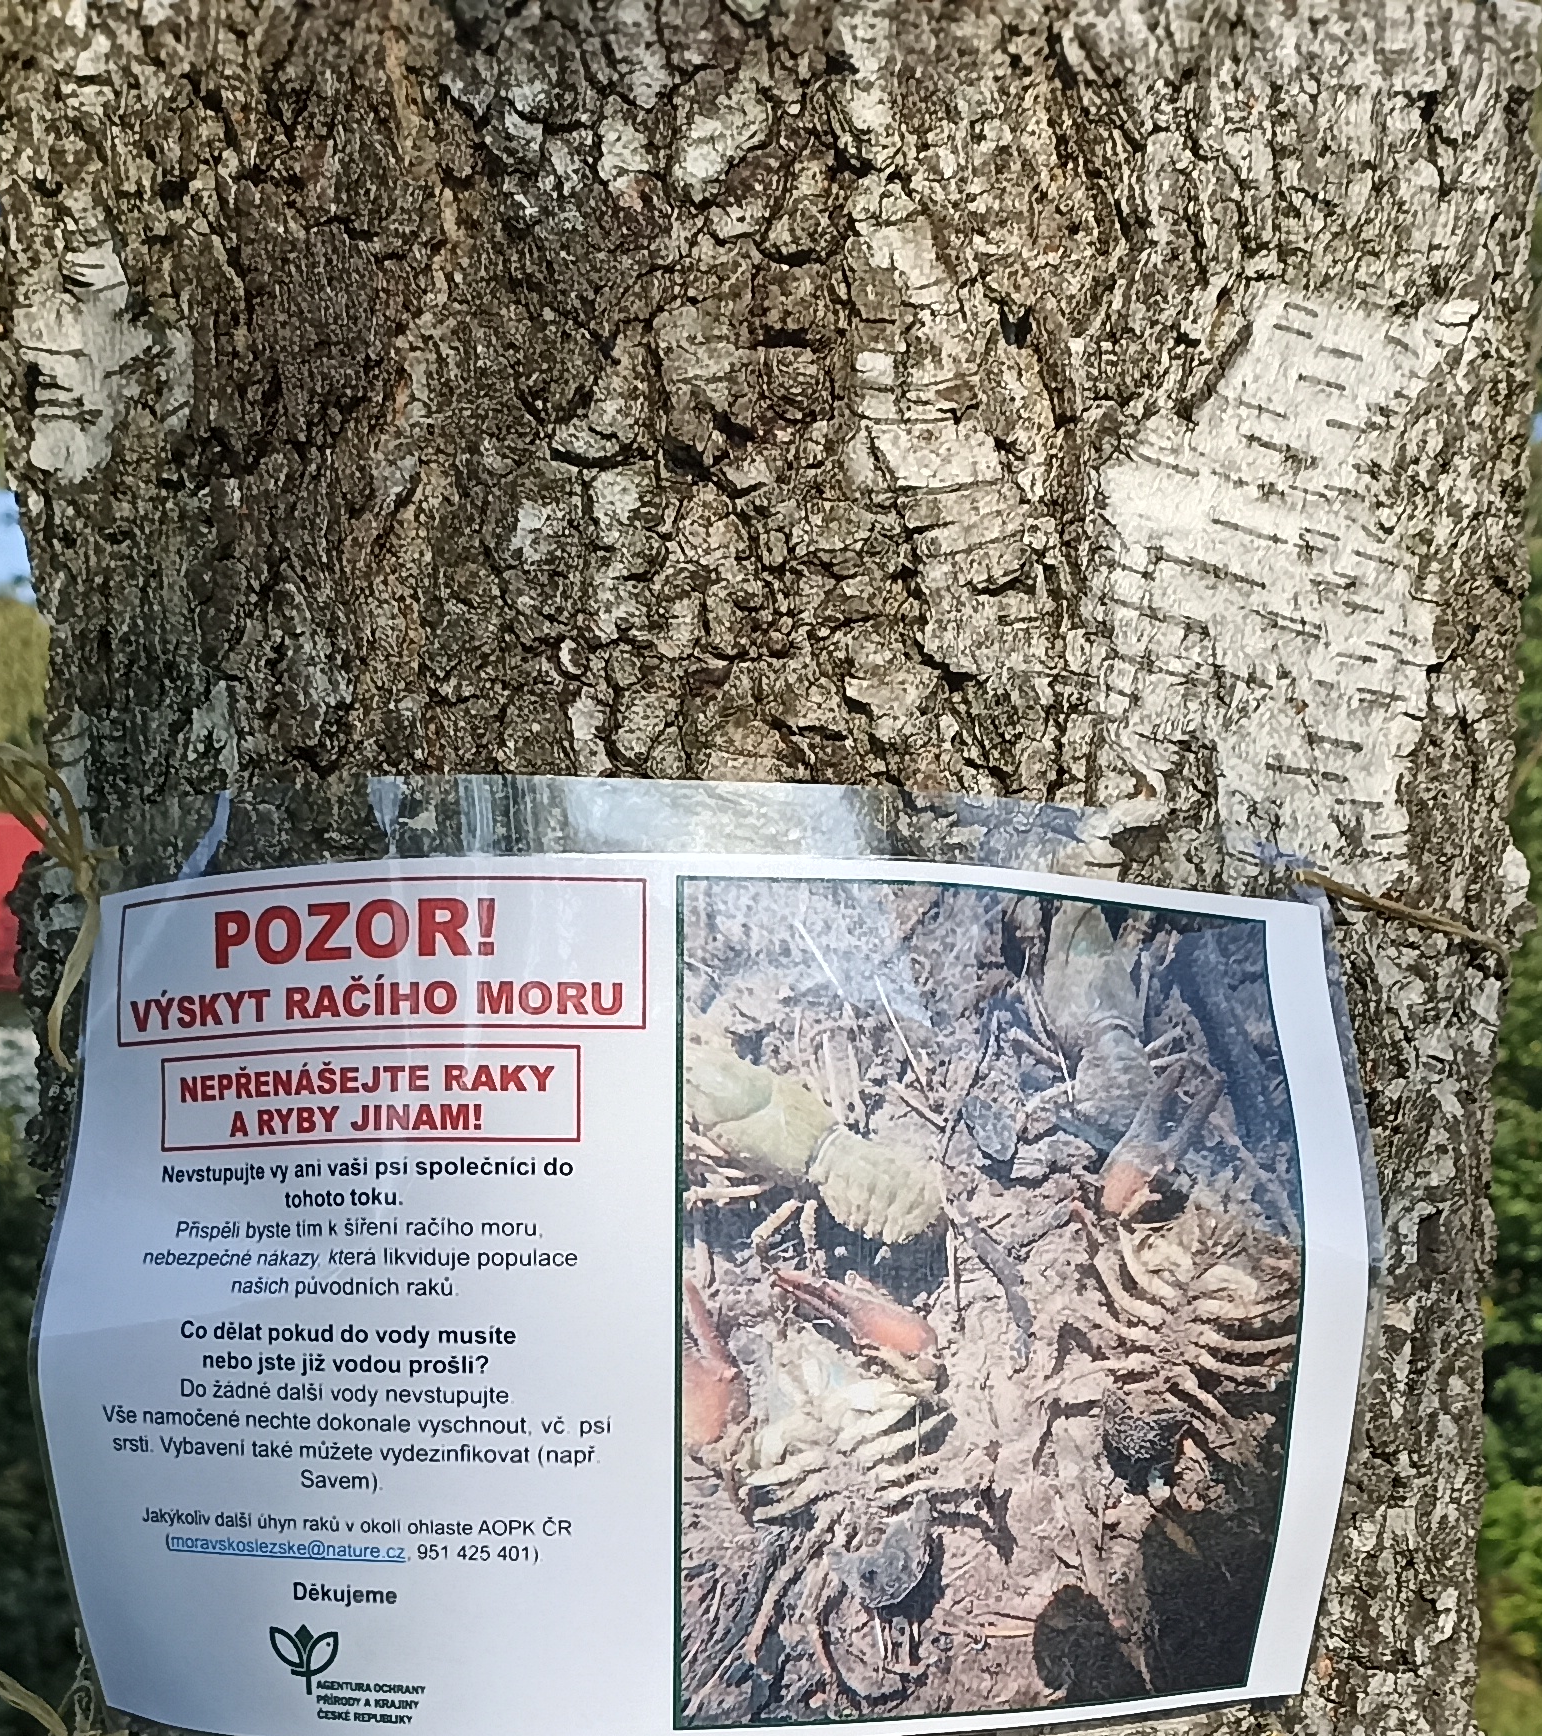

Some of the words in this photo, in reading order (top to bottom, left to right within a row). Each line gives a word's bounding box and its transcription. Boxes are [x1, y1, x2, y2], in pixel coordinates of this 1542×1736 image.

[213, 897, 497, 970] POZOR!
[129, 988, 272, 1033] VÝSKYT
[284, 975, 458, 1021] RAČÍHO
[476, 980, 624, 1017] MORU
[179, 1061, 430, 1105] NEPŘENÁŠEJTE
[443, 1064, 555, 1093] RAKY
[228, 1110, 250, 1138] A
[257, 1106, 340, 1137] RYBY
[350, 1104, 484, 1132] JINAM!
[161, 1162, 265, 1186] Nevstupujte
[269, 1164, 289, 1184] vy
[294, 1159, 322, 1178] ani
[327, 1157, 369, 1177] vaši
[375, 1156, 409, 1180] psí
[415, 1156, 537, 1181] společníci
[543, 1157, 574, 1177] do
[284, 1189, 345, 1209] tohoto
[350, 1186, 404, 1206] toku.
[175, 1220, 241, 1242] Přispěli
[245, 1220, 292, 1243] byste
[295, 1218, 323, 1238] tím
[328, 1219, 338, 1237] k
[344, 1217, 398, 1237] šíření
[406, 1216, 474, 1237] račího
[481, 1221, 543, 1240] moru,
[142, 1248, 252, 1270] nebezpečné
[328, 1247, 376, 1267] která
[383, 1246, 471, 1271] likviduje
[477, 1248, 578, 1270] populace
[230, 1276, 290, 1295] našich
[294, 1275, 400, 1299] původních
[180, 1320, 208, 1340] Co
[213, 1321, 263, 1341] dělat
[268, 1323, 334, 1345] pokud
[340, 1324, 369, 1344] do
[375, 1325, 430, 1349] vody
[438, 1325, 517, 1345] musíte
[202, 1351, 253, 1370] nebo
[256, 1351, 296, 1375] jste
[300, 1352, 326, 1377] již
[332, 1354, 401, 1374] vodou
[408, 1354, 490, 1378] prošli?
[180, 1378, 207, 1398] Do
[212, 1379, 271, 1400] žádné
[276, 1382, 324, 1401] další
[330, 1386, 379, 1408] vody
[102, 1404, 138, 1424] Vše
[142, 1407, 241, 1428] namočené
[245, 1411, 311, 1431] nechte
[317, 1412, 411, 1433] dokonale
[418, 1415, 532, 1438] vyschnout,
[579, 1415, 612, 1438] psí
[112, 1435, 154, 1453] srsti.
[159, 1435, 246, 1459] Vybavení
[251, 1440, 293, 1459] také
[299, 1440, 373, 1462] můžete
[379, 1443, 530, 1467] vydezinfikovat
[300, 1469, 384, 1494] Savem).
[142, 1506, 211, 1527] Jakýkoliv
[214, 1511, 252, 1529] další
[257, 1512, 297, 1534] úhyn
[302, 1515, 340, 1532] raků
[344, 1520, 354, 1532] v
[360, 1518, 401, 1534] okolí
[407, 1519, 473, 1536] ohlaste
[478, 1519, 536, 1537] AOPK
[542, 1516, 573, 1537] ČR
[416, 1543, 449, 1561] 951
[456, 1544, 491, 1562] 425
[293, 1581, 398, 1607] Děkujeme
[373, 1682, 426, 1695] OCHRANY
[316, 1707, 351, 1721] ČESKÉ
[363, 1698, 371, 1708] A
